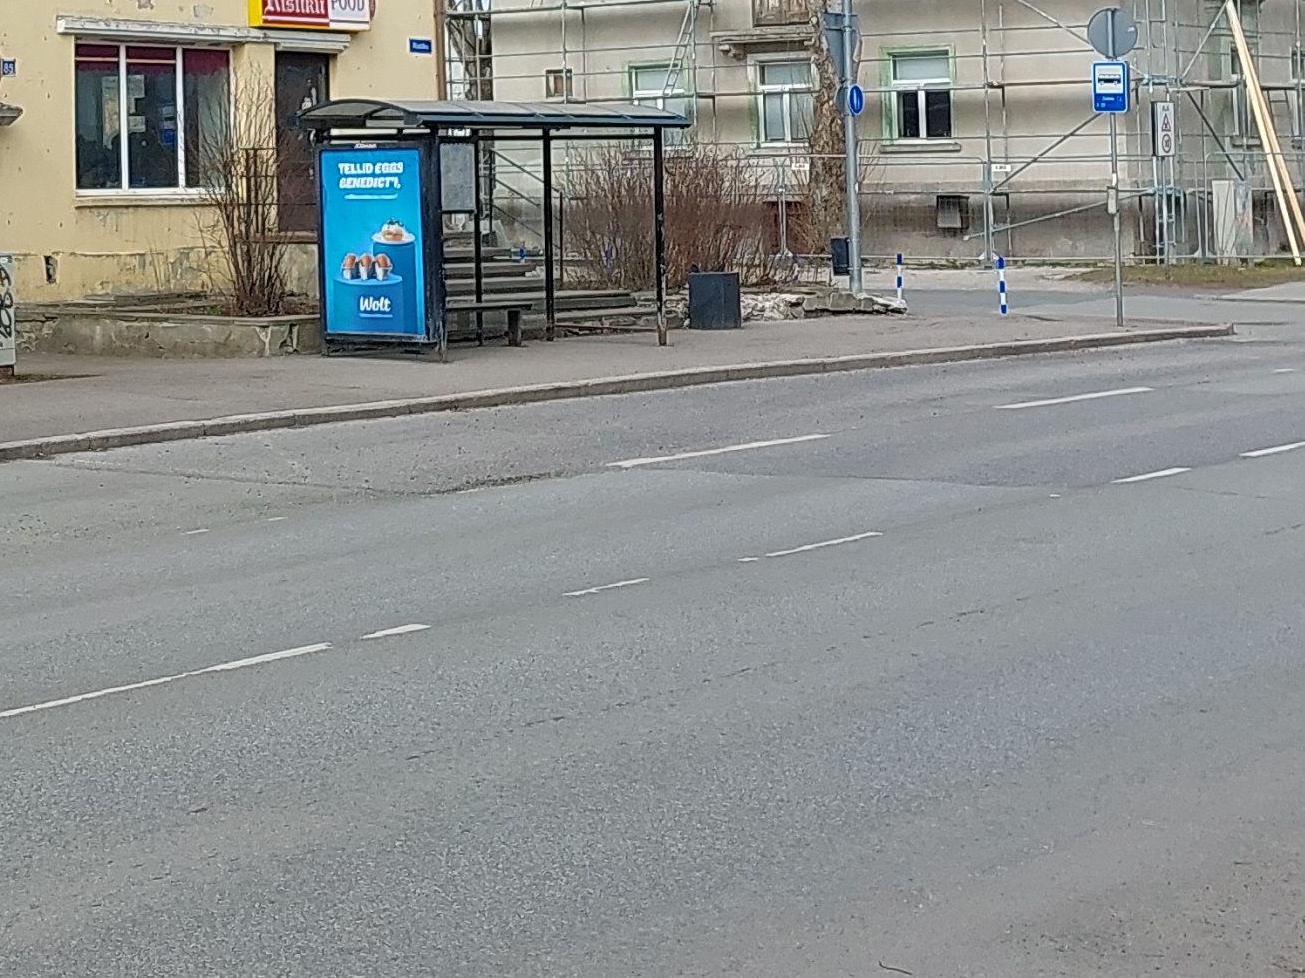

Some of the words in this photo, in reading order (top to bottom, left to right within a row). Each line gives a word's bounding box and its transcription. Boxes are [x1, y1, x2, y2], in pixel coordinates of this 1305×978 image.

[337, 162, 374, 175] TELLID
[374, 161, 404, 174] EGGS
[359, 295, 391, 313] Wolt
